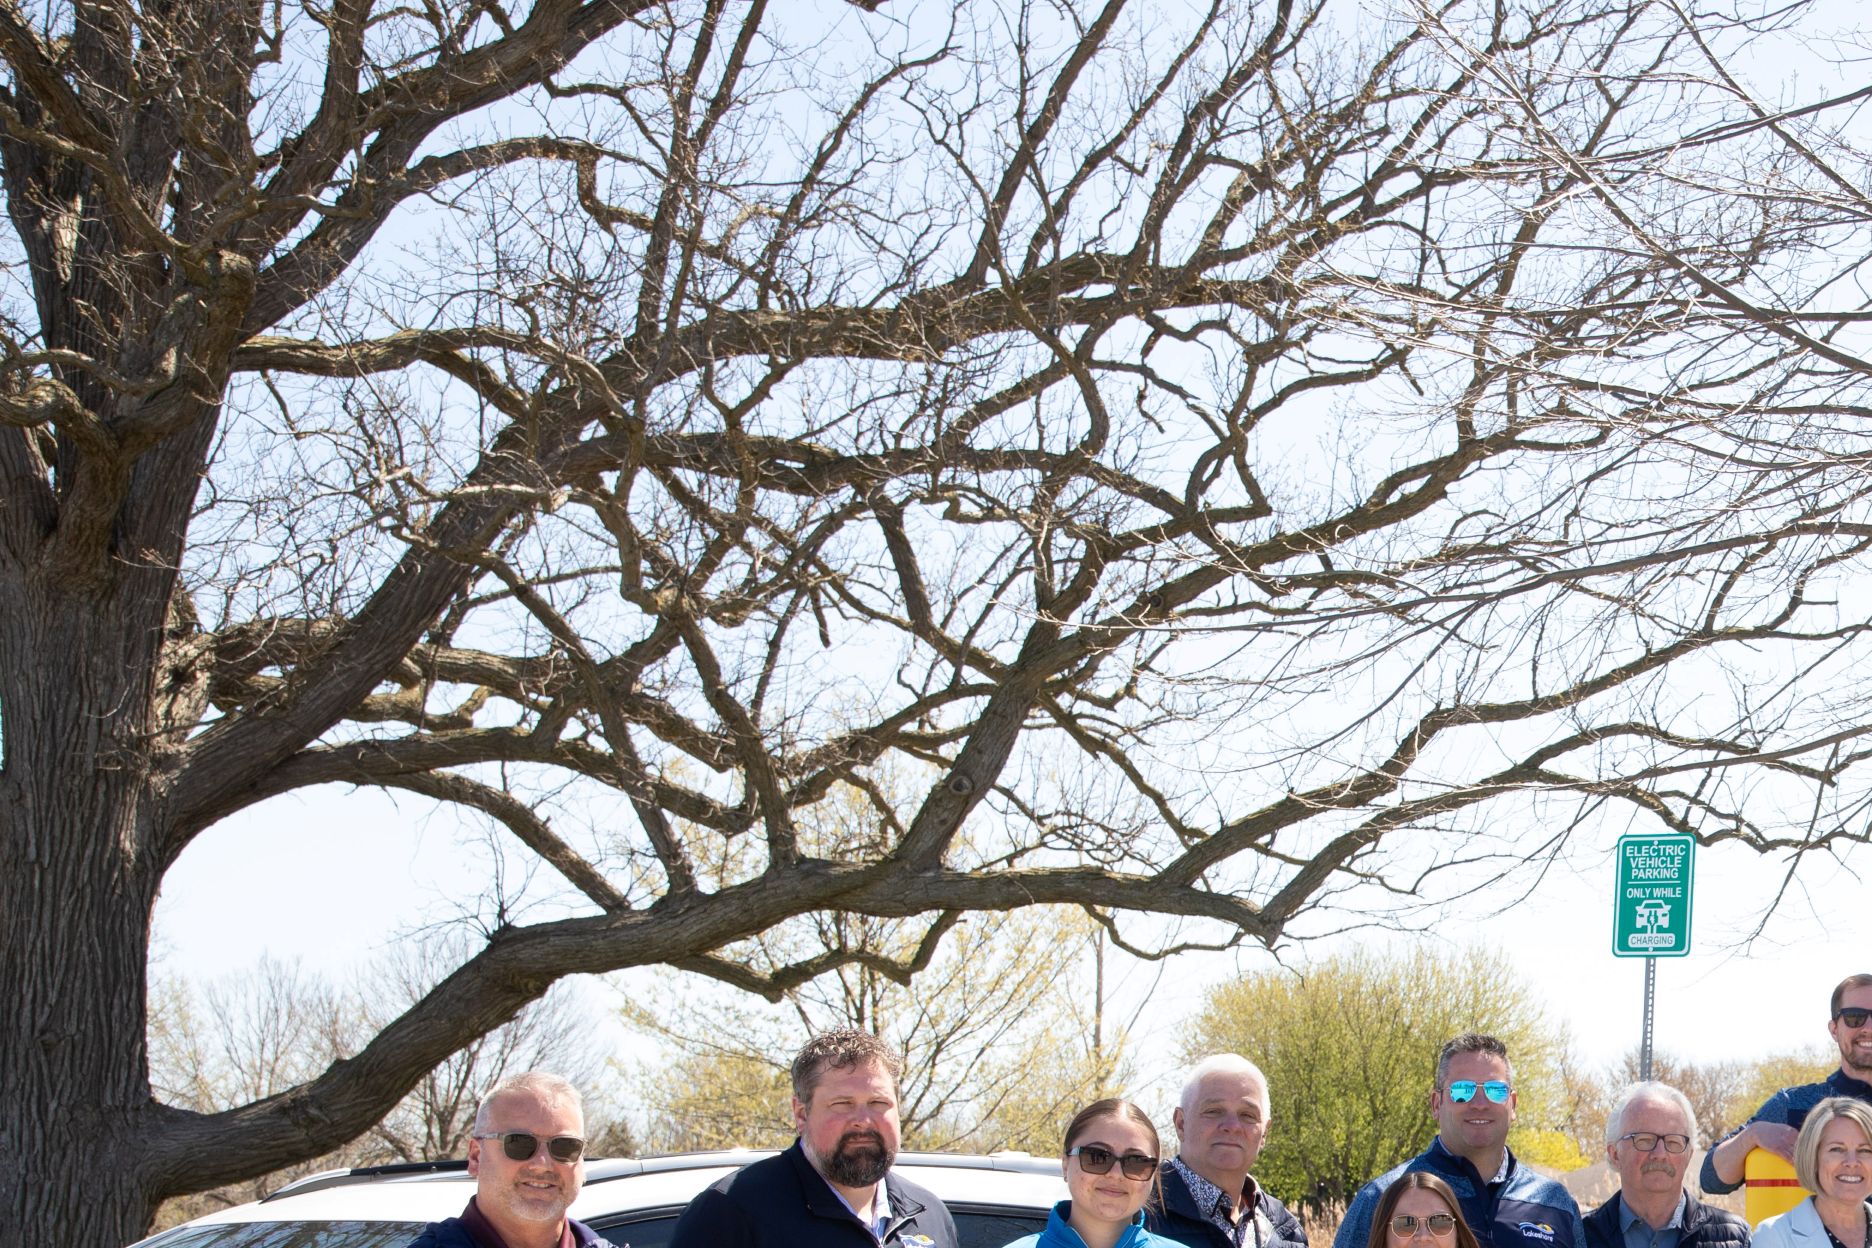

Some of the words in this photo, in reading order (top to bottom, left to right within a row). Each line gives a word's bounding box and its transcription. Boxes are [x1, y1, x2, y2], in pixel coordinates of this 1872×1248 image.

[1625, 844, 1686, 857] ELECTRIC
[1629, 856, 1682, 868] VEHICLE
[1631, 868, 1679, 879] PARKING
[1626, 887, 1651, 899] ONLY
[1653, 887, 1682, 898] WHILE
[1630, 935, 1674, 945] CHARGING
[1522, 1229, 1554, 1242] Lakeshore
